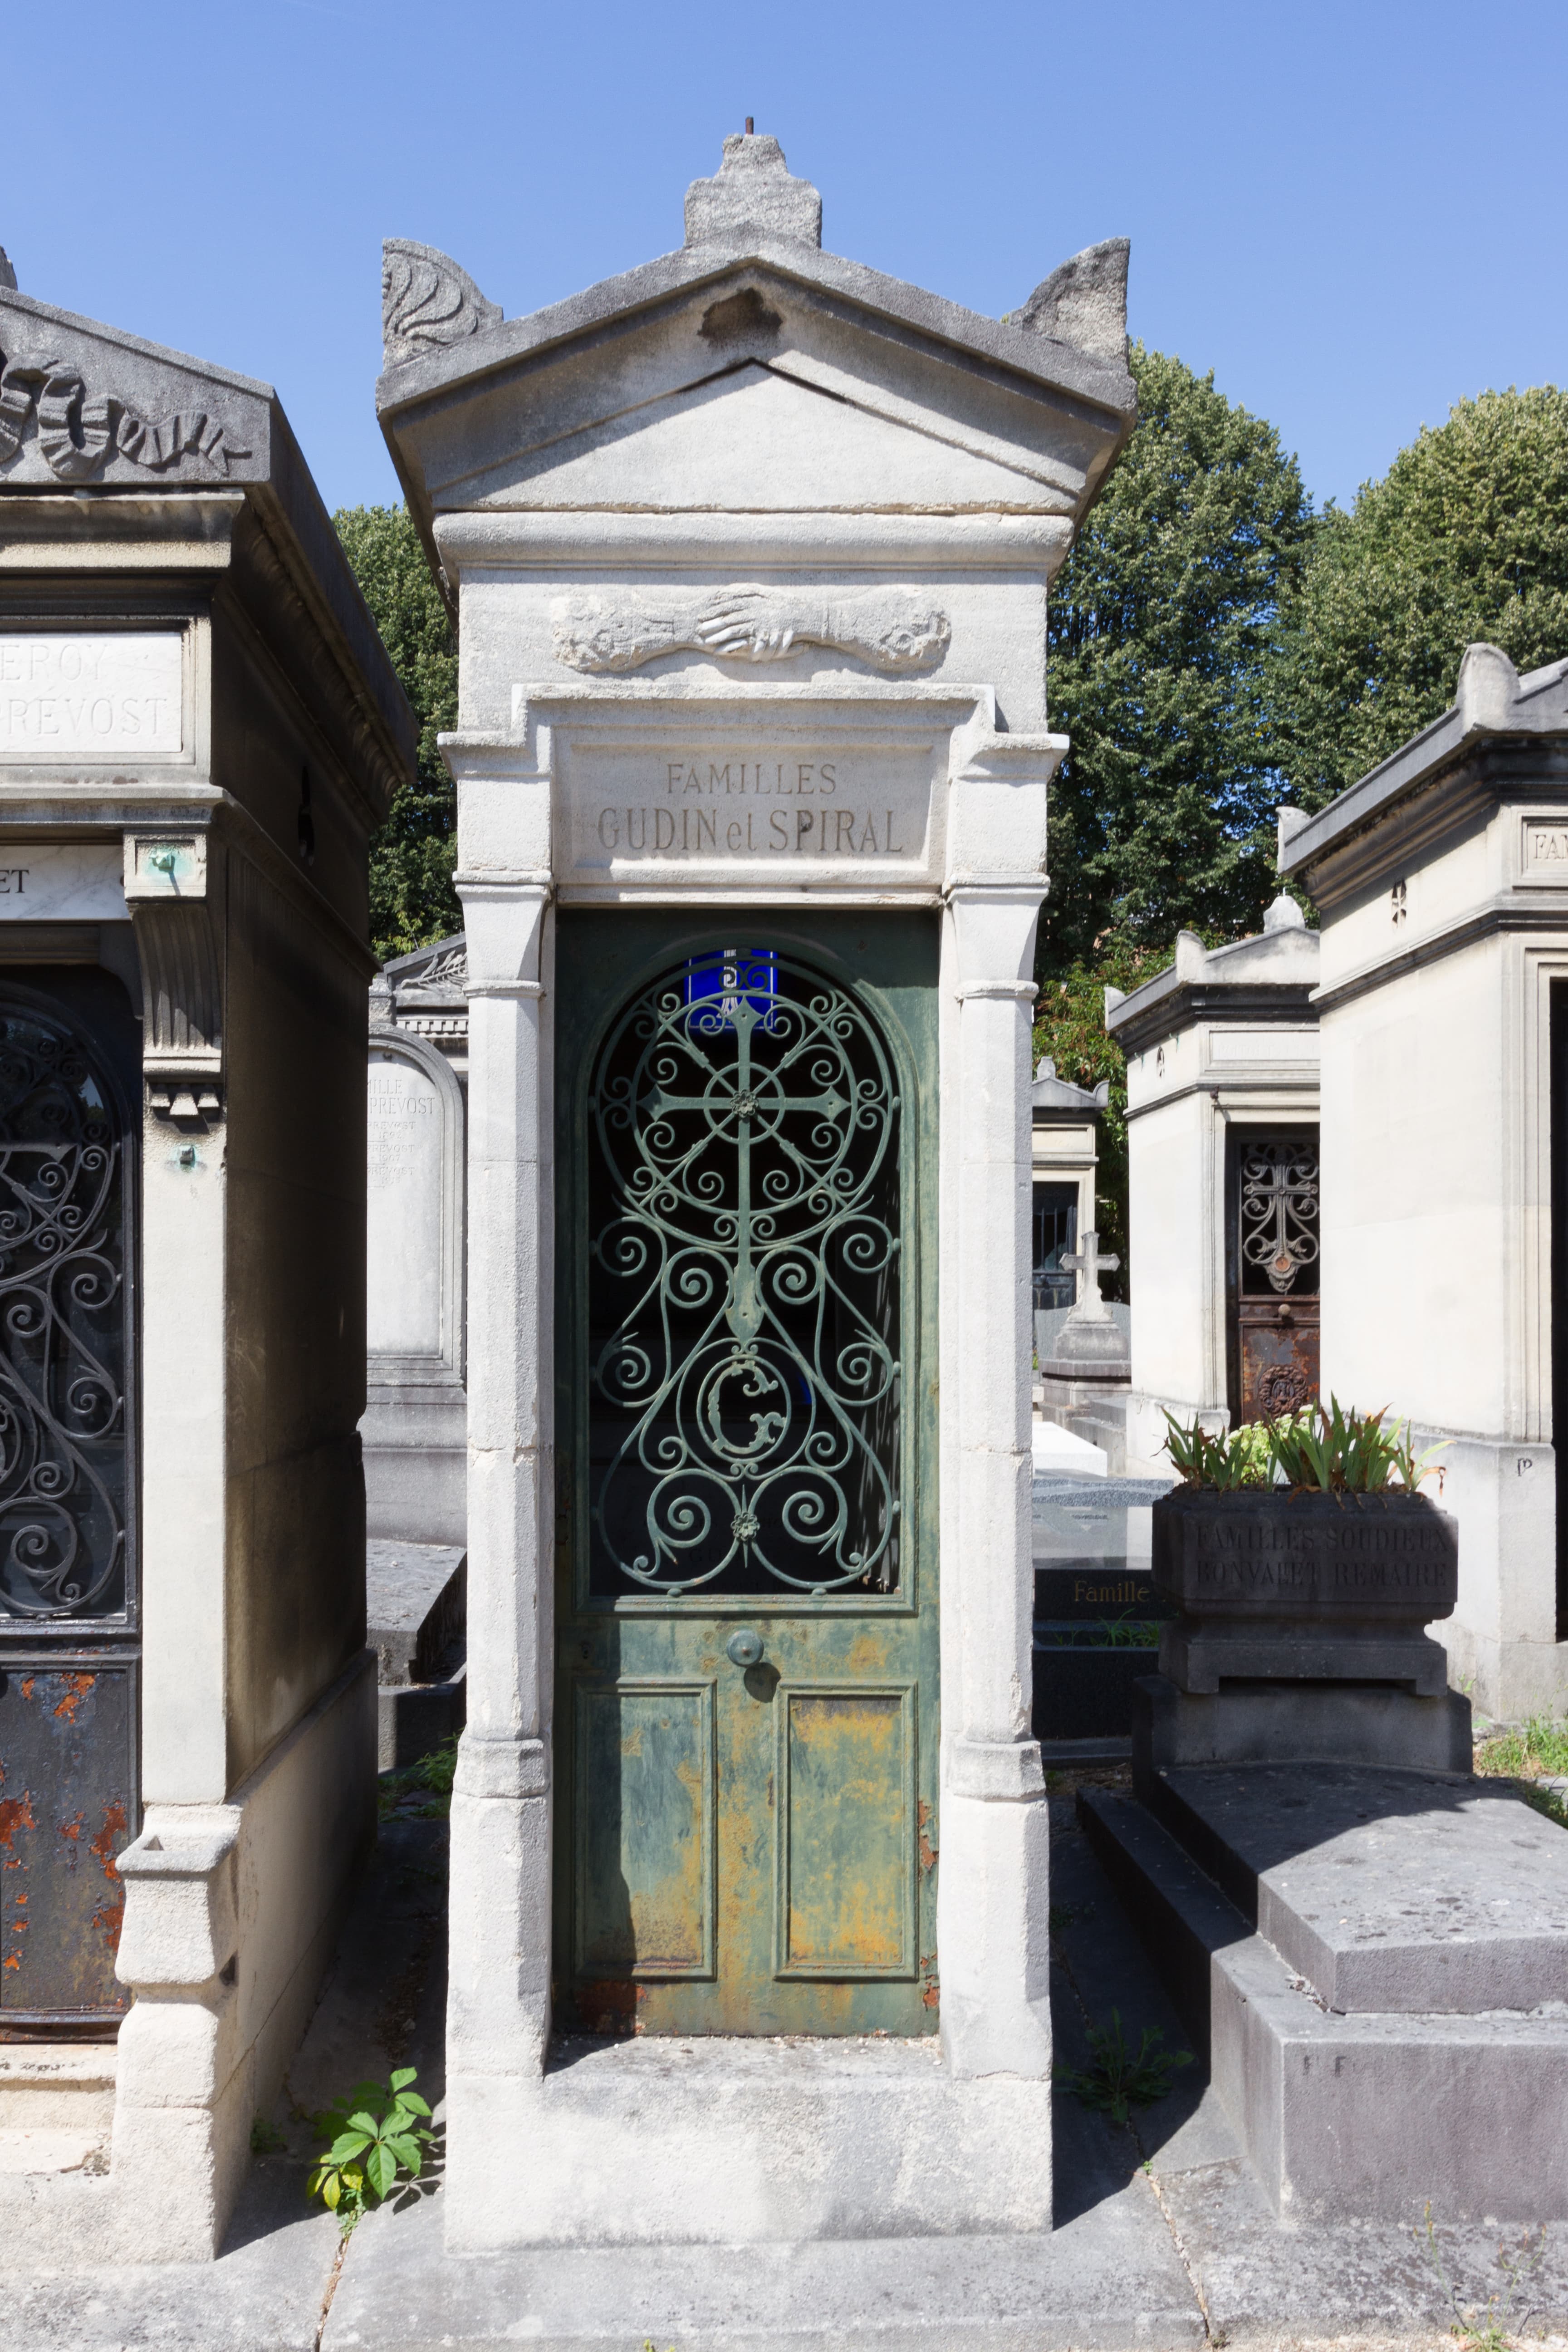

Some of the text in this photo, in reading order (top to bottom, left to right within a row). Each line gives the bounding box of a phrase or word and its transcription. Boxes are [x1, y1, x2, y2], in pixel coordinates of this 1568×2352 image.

[0, 698, 167, 736] REVOST
[666, 763, 837, 795] FAMILLES
[598, 807, 717, 851] GUDIN
[769, 809, 903, 853] SPIRAL
[370, 1097, 435, 1115] PREVOST
[1197, 1527, 1314, 1551] FAMILLES
[1074, 1580, 1151, 1603] Famille
